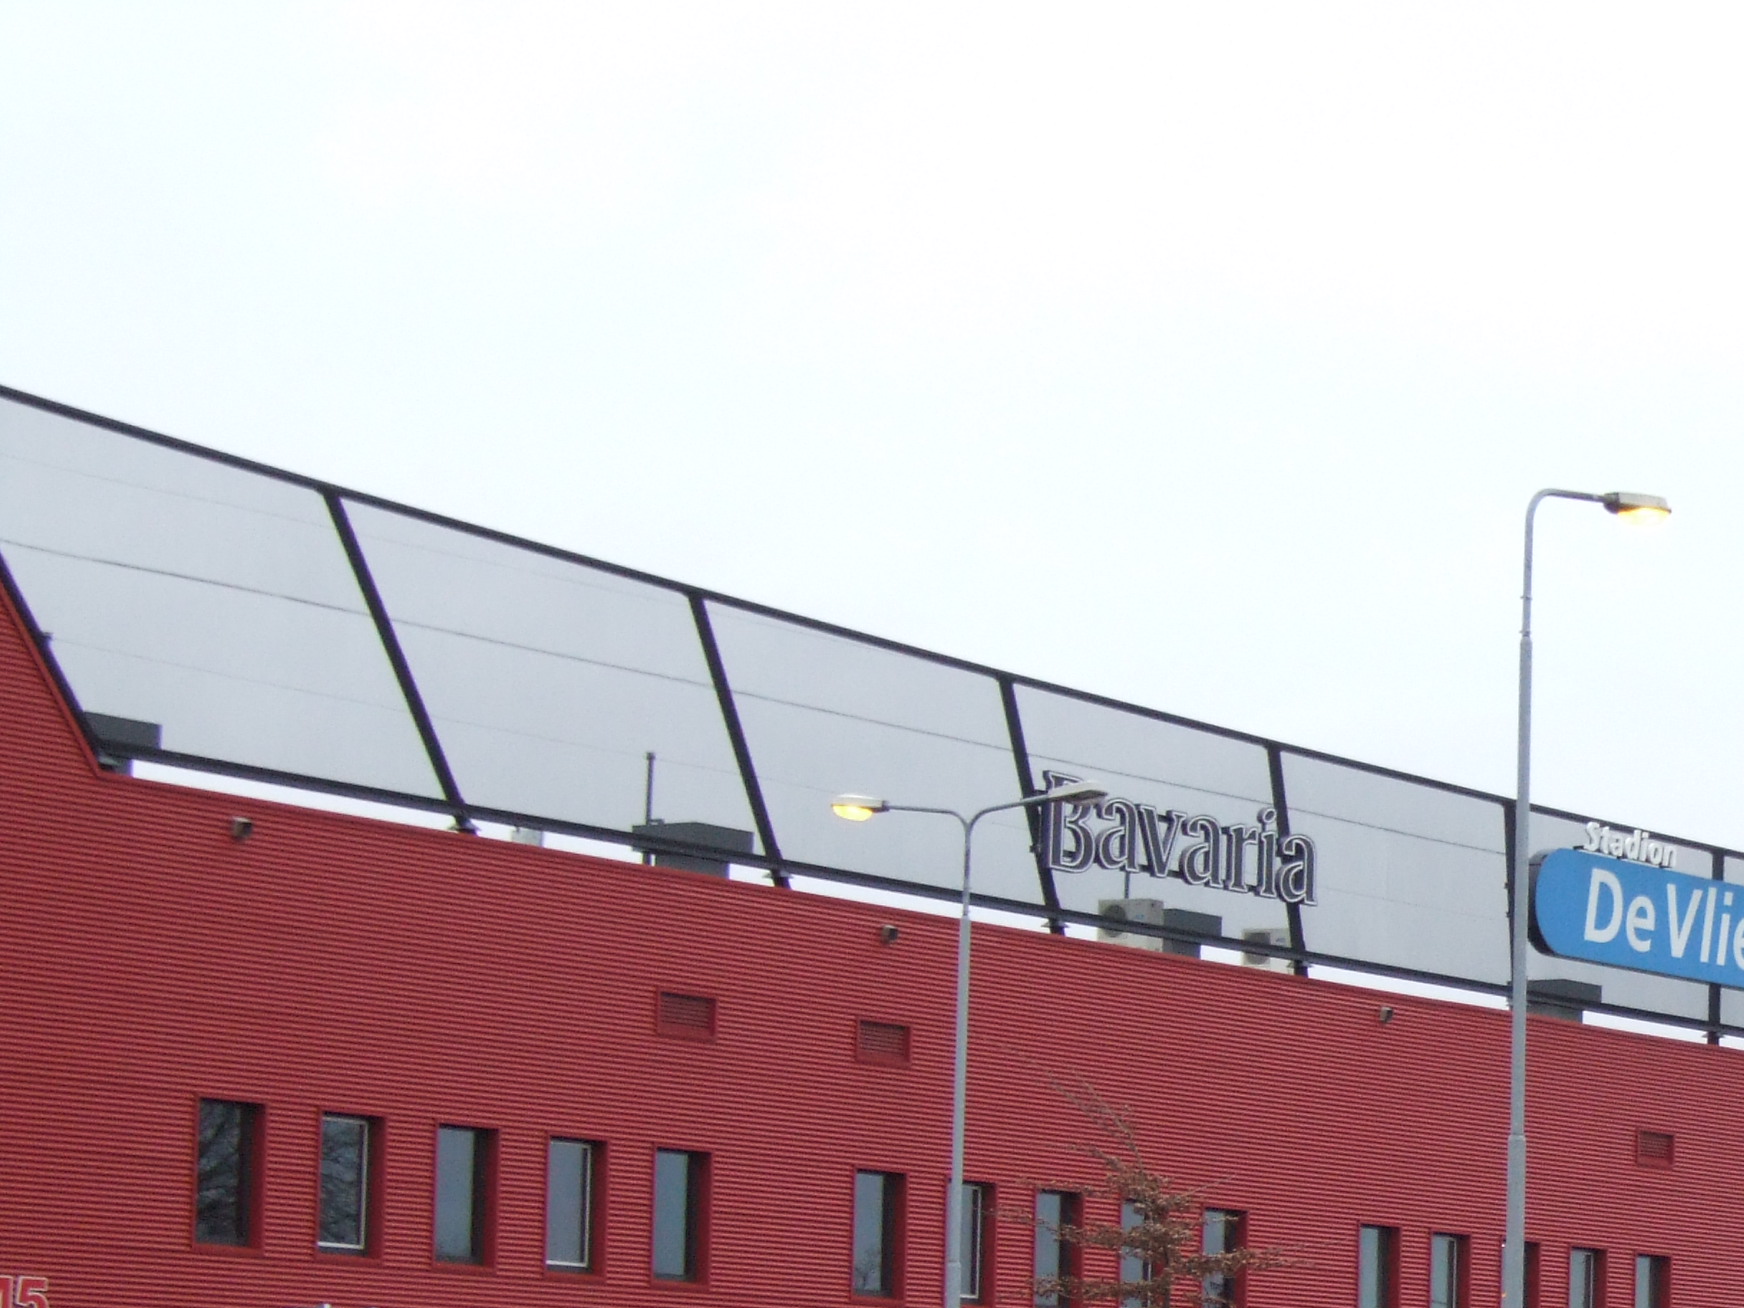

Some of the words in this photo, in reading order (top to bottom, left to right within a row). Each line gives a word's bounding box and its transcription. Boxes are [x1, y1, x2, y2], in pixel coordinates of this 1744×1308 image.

[1043, 771, 1318, 906] Bavaria
[1583, 821, 1677, 867] Stadion
[1584, 868, 1656, 953] De
